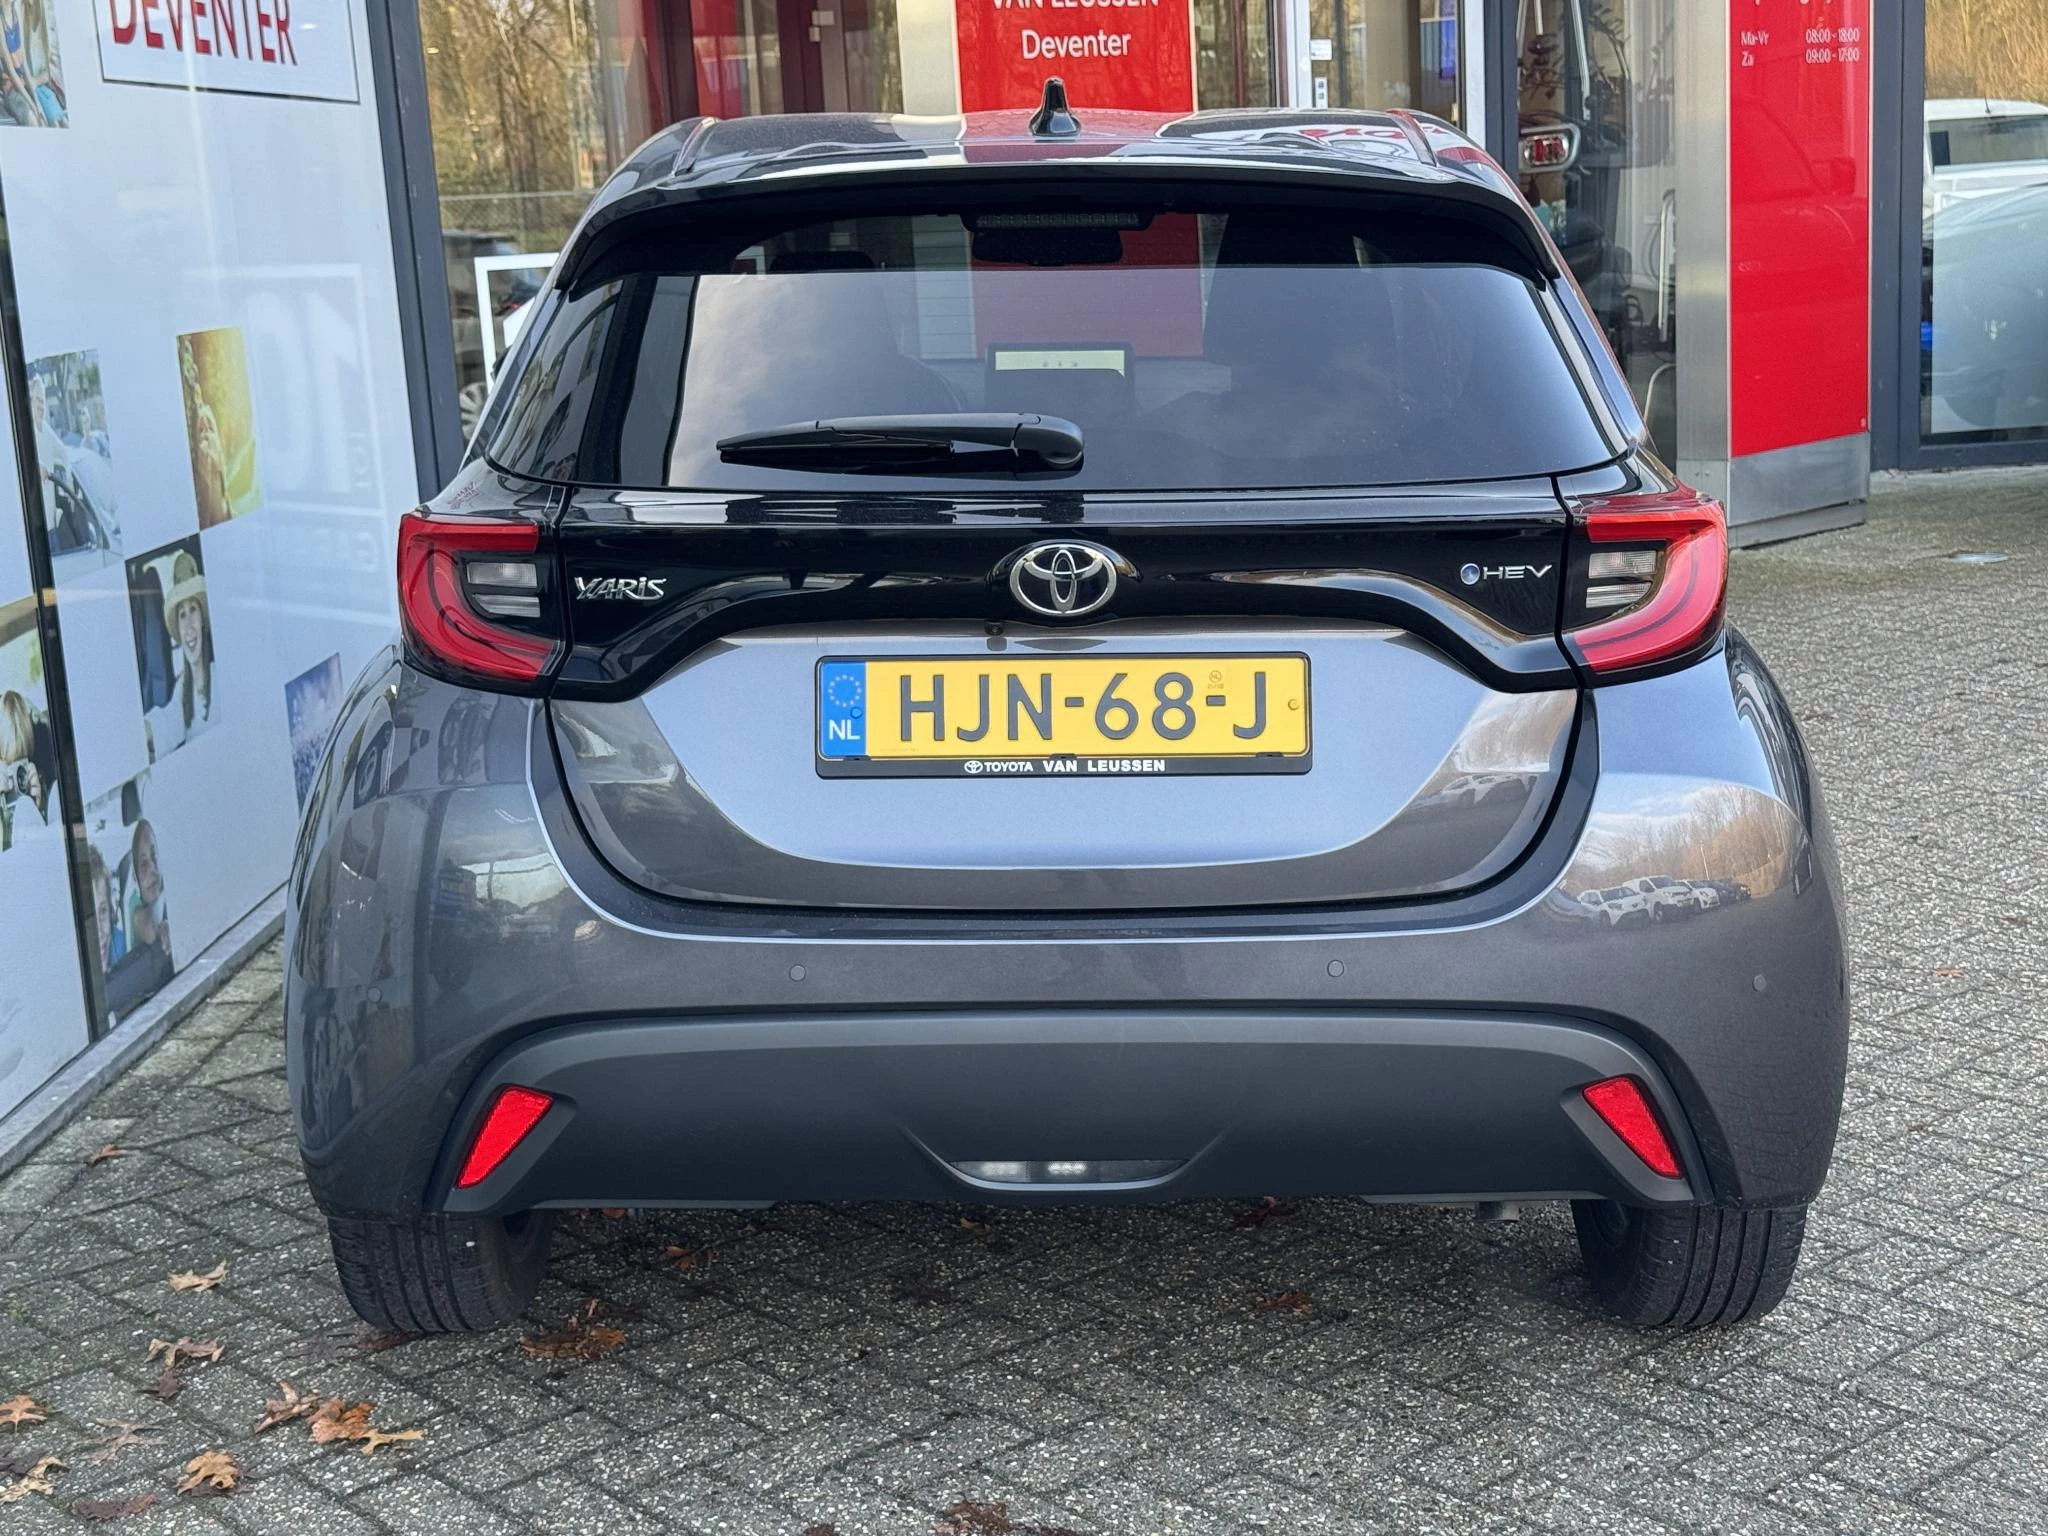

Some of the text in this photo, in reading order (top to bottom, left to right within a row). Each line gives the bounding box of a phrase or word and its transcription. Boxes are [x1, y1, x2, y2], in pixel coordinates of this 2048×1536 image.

[1021, 29, 1131, 59] Deventer
[1741, 51, 1754, 67] Za
[1482, 564, 1553, 580] HEV
[828, 671, 1267, 743] NL HJN-68-J
[983, 759, 1166, 773] TOYOTA VAN LEUSSEN
